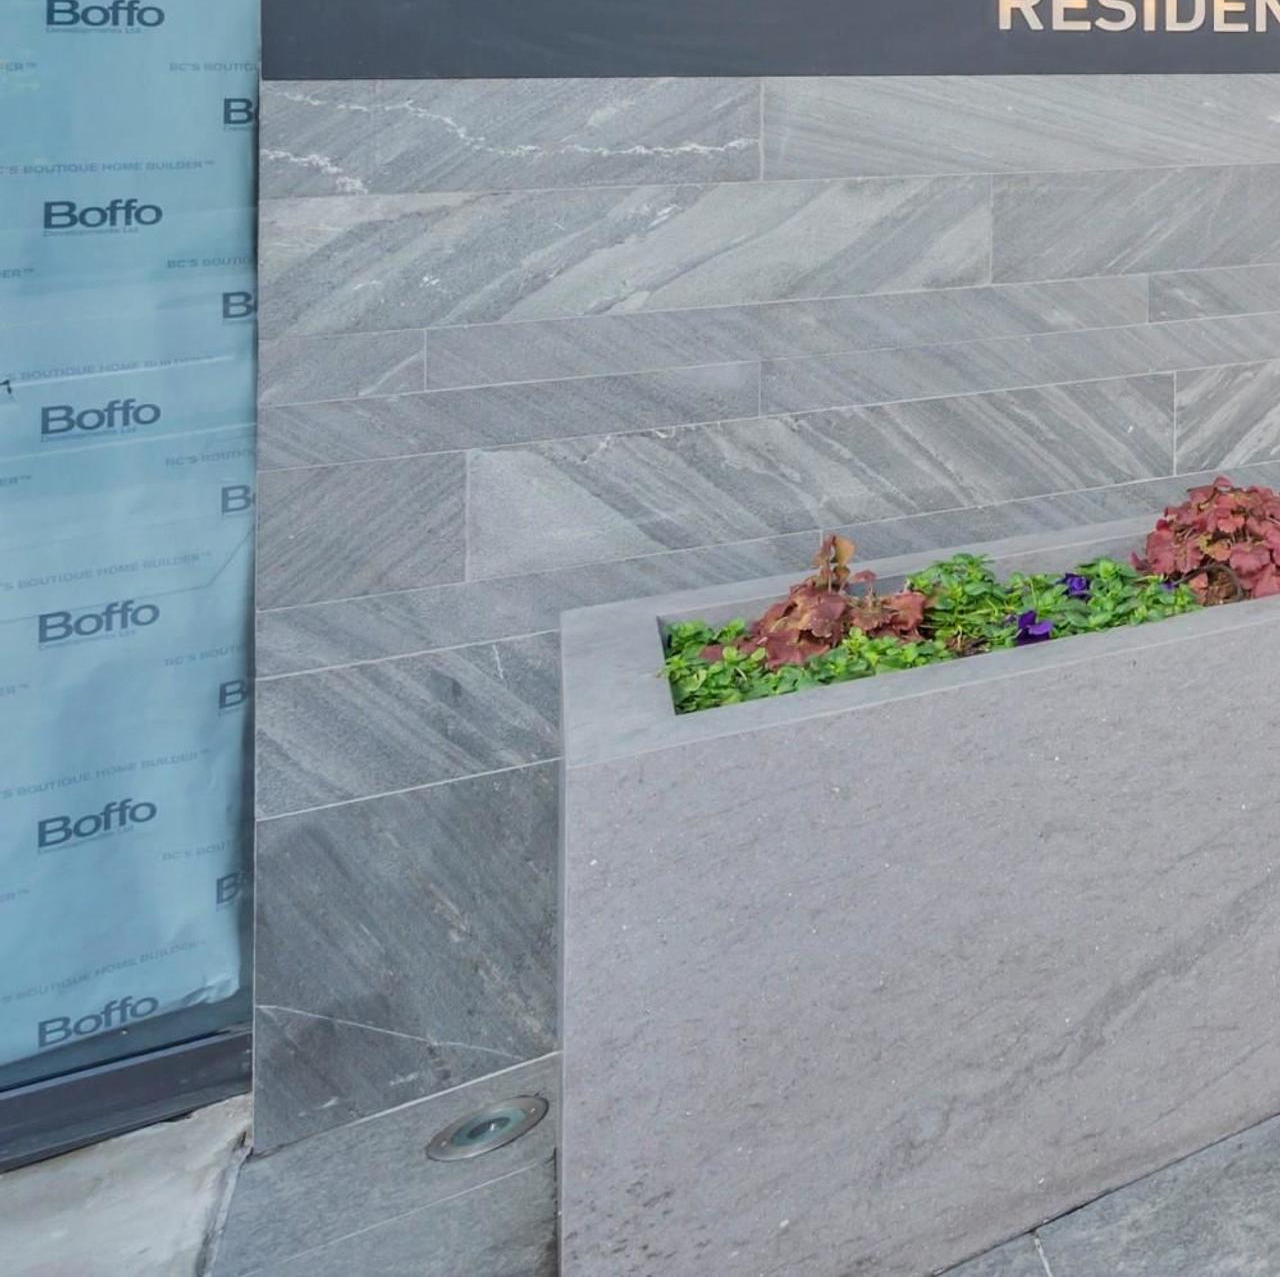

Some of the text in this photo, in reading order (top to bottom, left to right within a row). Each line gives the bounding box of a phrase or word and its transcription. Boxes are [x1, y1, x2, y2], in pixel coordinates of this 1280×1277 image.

[43, 199, 163, 229] Boffo
[41, 398, 161, 435] Boffo
[38, 600, 160, 643] Boffo
[38, 798, 157, 848] Boffo
[38, 995, 159, 1049] Boffo
